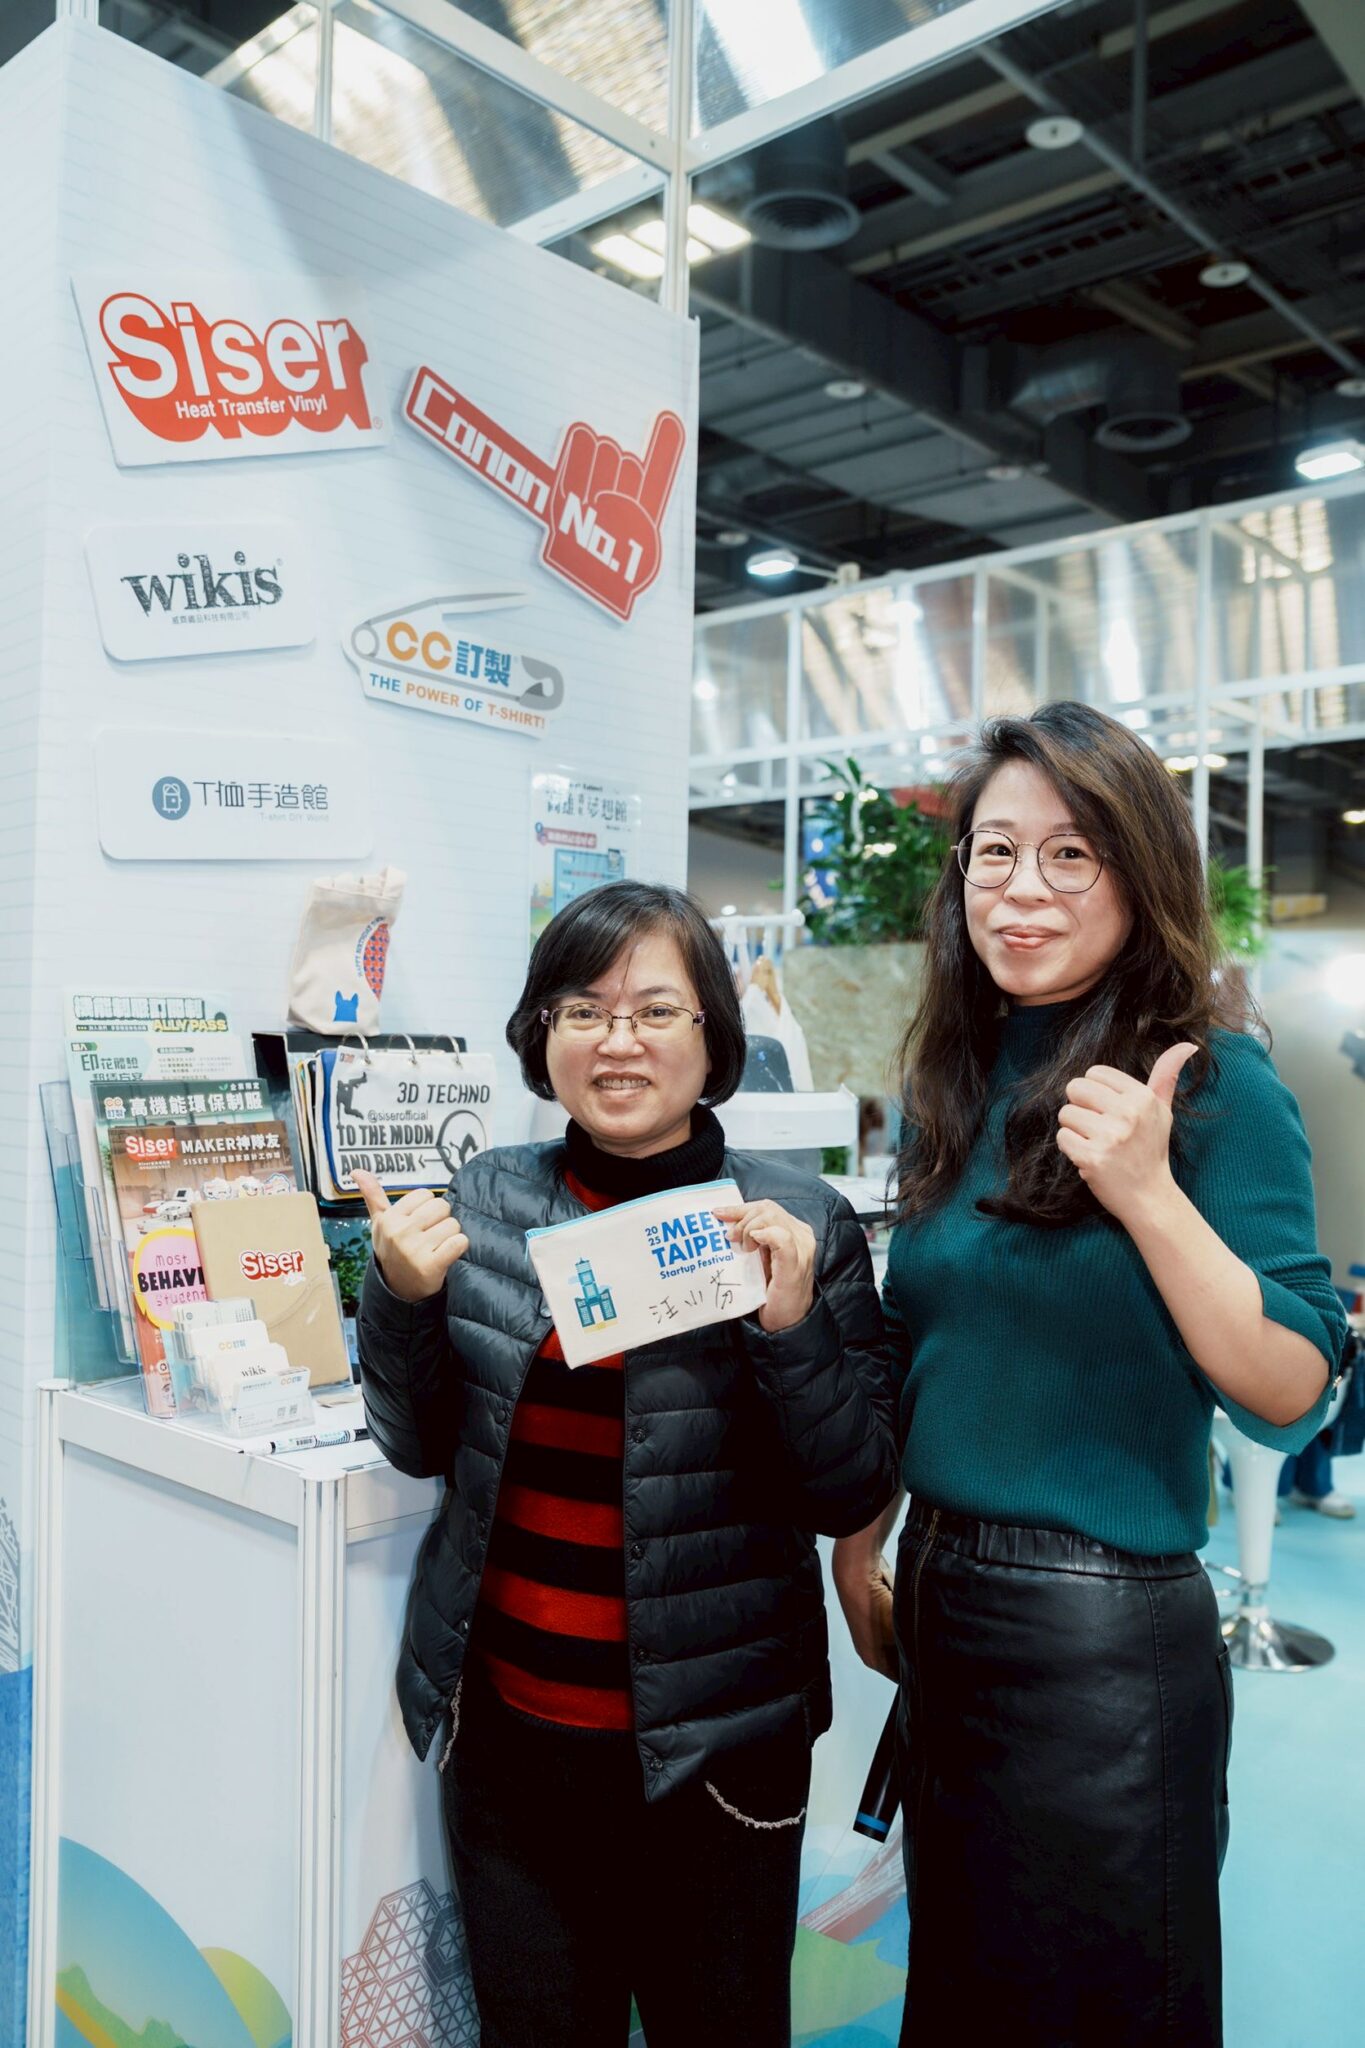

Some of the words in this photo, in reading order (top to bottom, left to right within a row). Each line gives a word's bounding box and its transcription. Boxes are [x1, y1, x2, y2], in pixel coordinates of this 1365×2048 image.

[100, 293, 360, 402] Siser
[175, 400, 216, 419] Heat
[218, 397, 286, 417] Transfer
[288, 394, 328, 415] Vinyl
[412, 374, 551, 514] Canon
[559, 491, 644, 584] No.1
[120, 551, 284, 617] wikis
[387, 621, 512, 687] CC訂製
[369, 673, 400, 693] THE
[406, 682, 460, 707] POWER
[464, 697, 483, 713] OF
[487, 703, 546, 729] T-SHIRT!
[193, 780, 329, 810] T恤手造館
[153, 1018, 188, 1033] ALLY
[191, 1018, 228, 1033] PASS
[129, 1091, 264, 1117] 高機能環保制服
[397, 1082, 419, 1104] 3D
[427, 1084, 491, 1104] TECHNO
[368, 1110, 429, 1123] @siserofficial
[124, 1135, 177, 1156] Siser
[337, 1124, 357, 1147] TO
[360, 1124, 387, 1146] THE
[390, 1124, 434, 1146] MOON
[183, 1157, 208, 1166] SISER
[341, 1153, 371, 1176] AND
[375, 1153, 416, 1174] BACK
[645, 1226, 658, 1237] 20
[661, 1211, 725, 1242] MEE
[648, 1236, 661, 1246] 25
[240, 1250, 305, 1281] Siser
[660, 1264, 696, 1279] Startup
[698, 1252, 734, 1269] Festival
[241, 1365, 267, 1377] wikis
